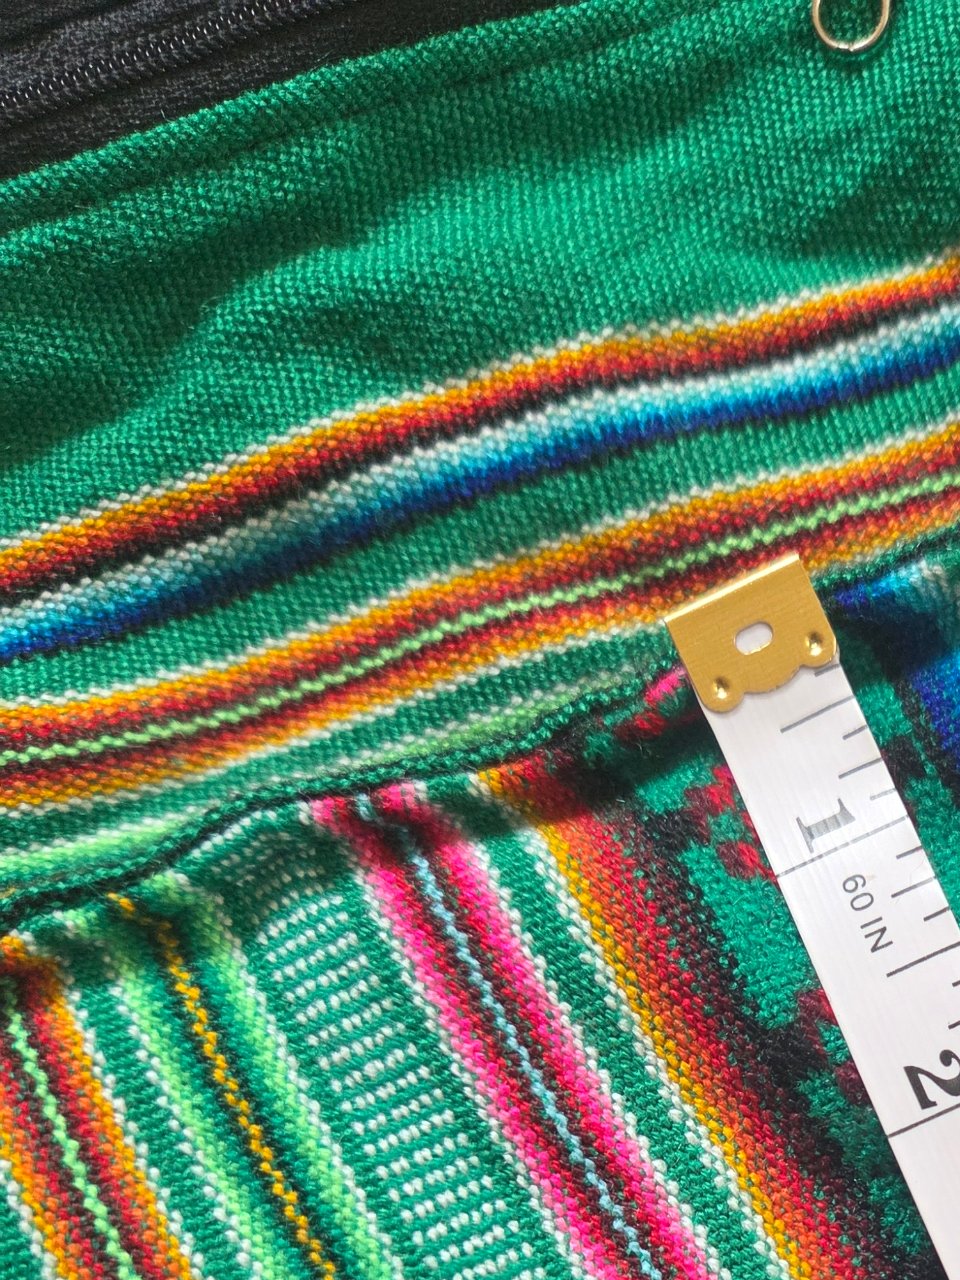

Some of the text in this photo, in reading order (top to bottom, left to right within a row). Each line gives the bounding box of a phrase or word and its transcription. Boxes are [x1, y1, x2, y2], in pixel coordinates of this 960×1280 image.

[796, 798, 855, 853] 1
[842, 873, 894, 953] 60 IN
